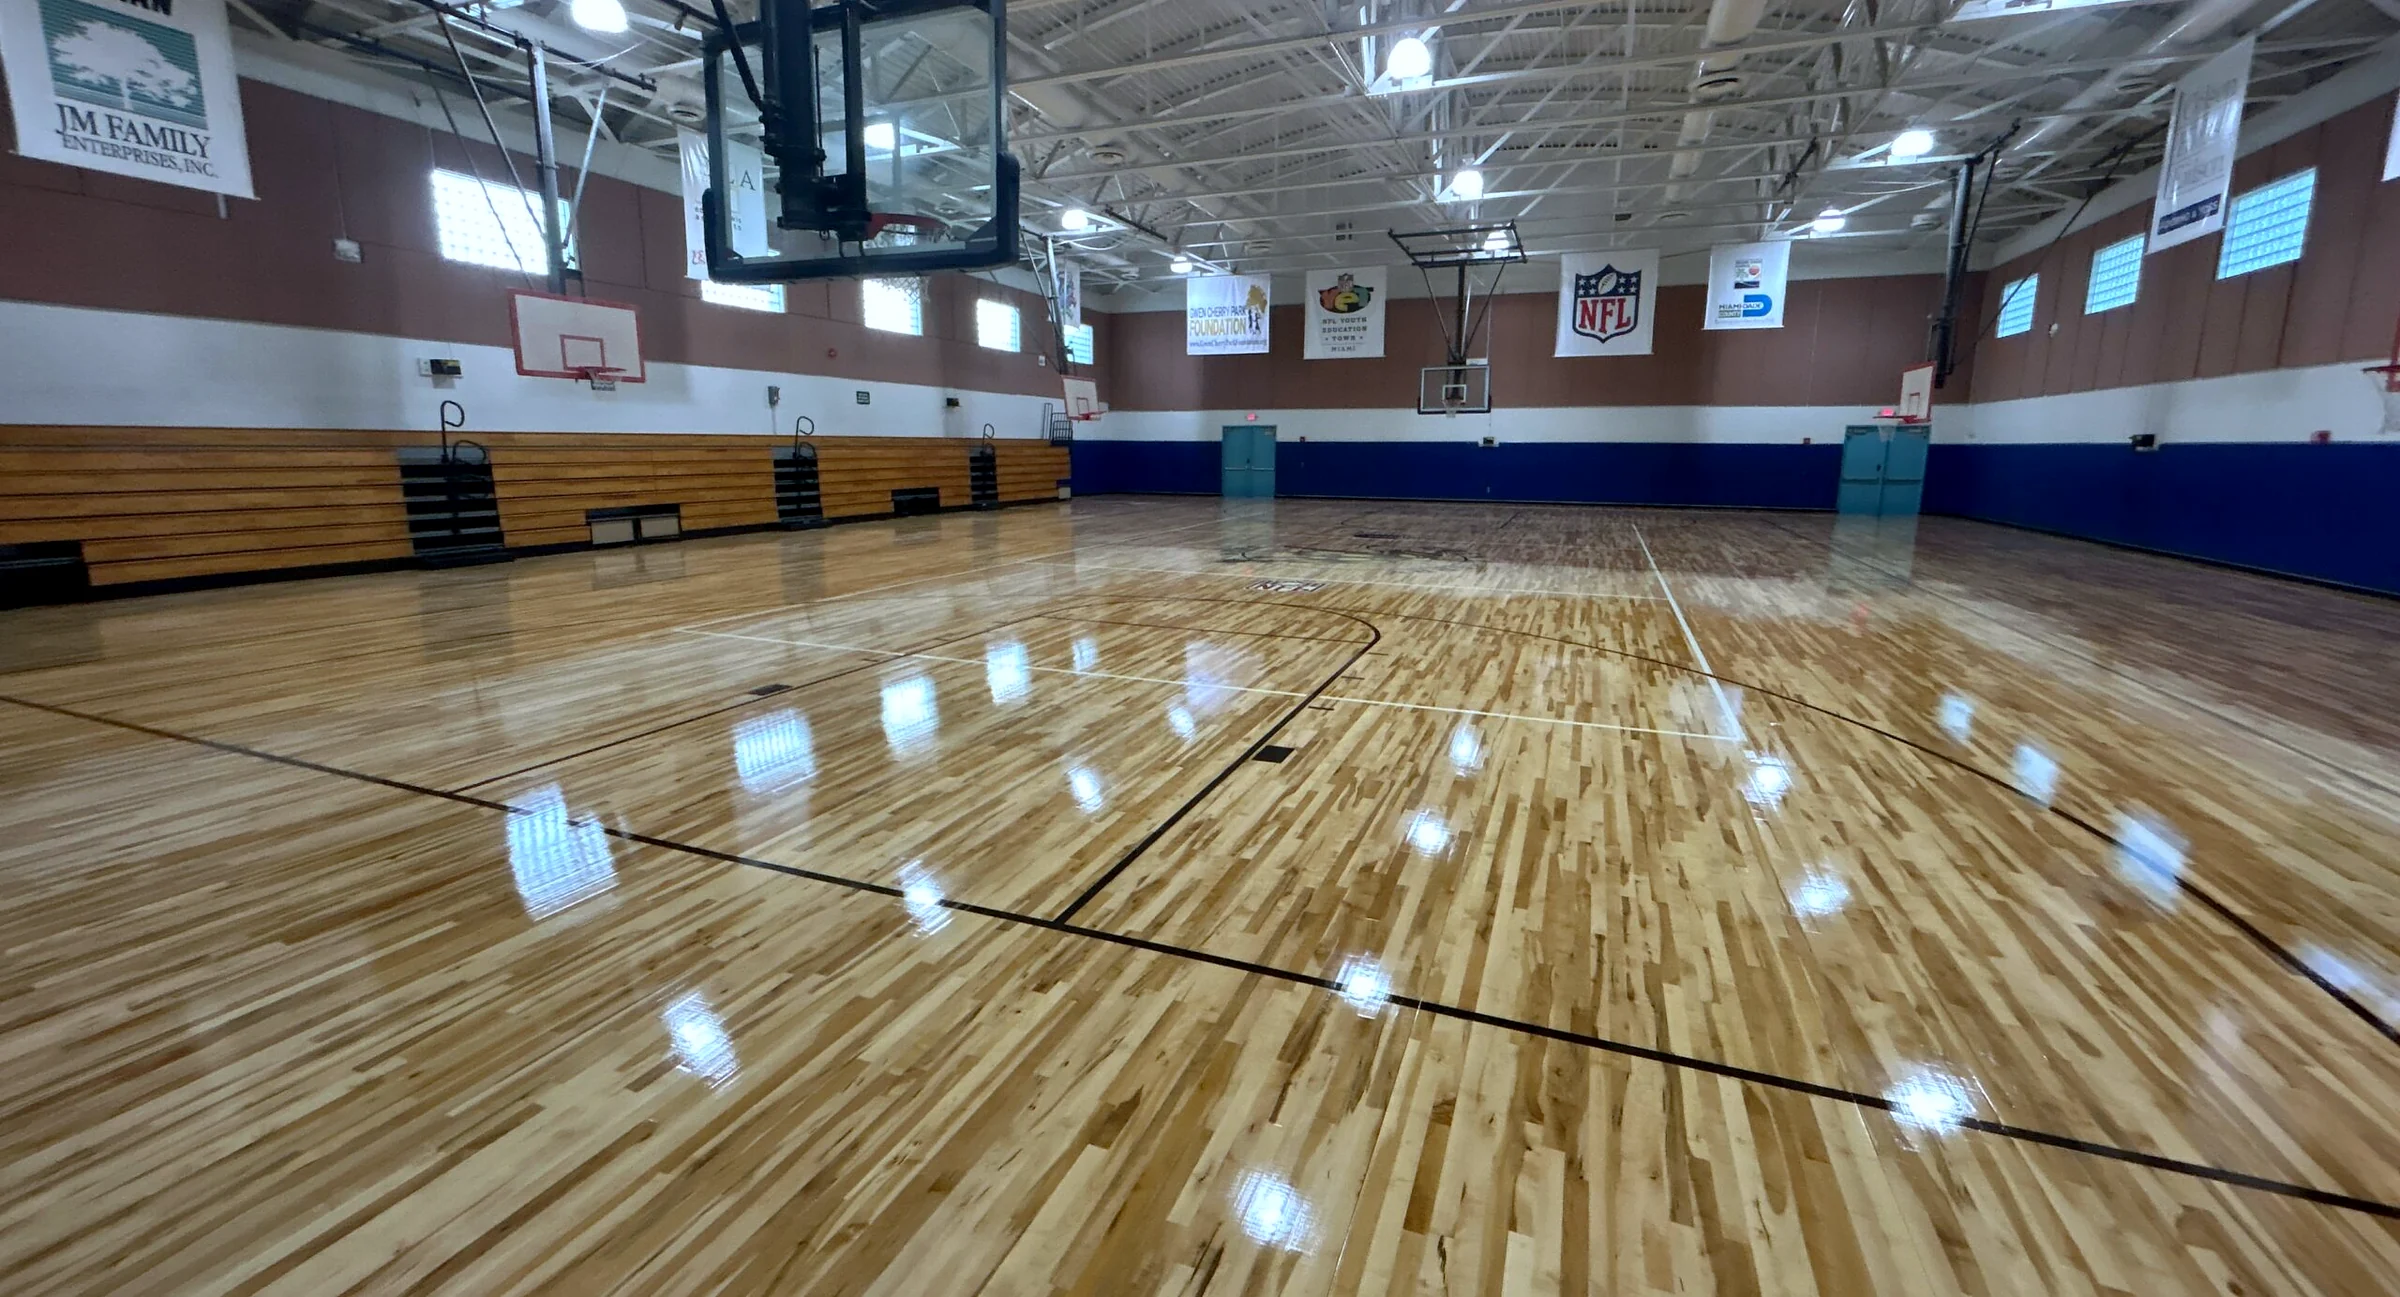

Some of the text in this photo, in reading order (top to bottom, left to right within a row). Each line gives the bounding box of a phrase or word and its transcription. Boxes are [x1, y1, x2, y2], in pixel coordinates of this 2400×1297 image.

[55, 103, 211, 159] JM FAMILY
[62, 134, 184, 174] ENTERPRISES,
[1190, 318, 1247, 336] FOUNDATION
[1207, 306, 1230, 318] CHERRY
[1231, 305, 1247, 317] PARK
[1579, 299, 1631, 334] NFL
